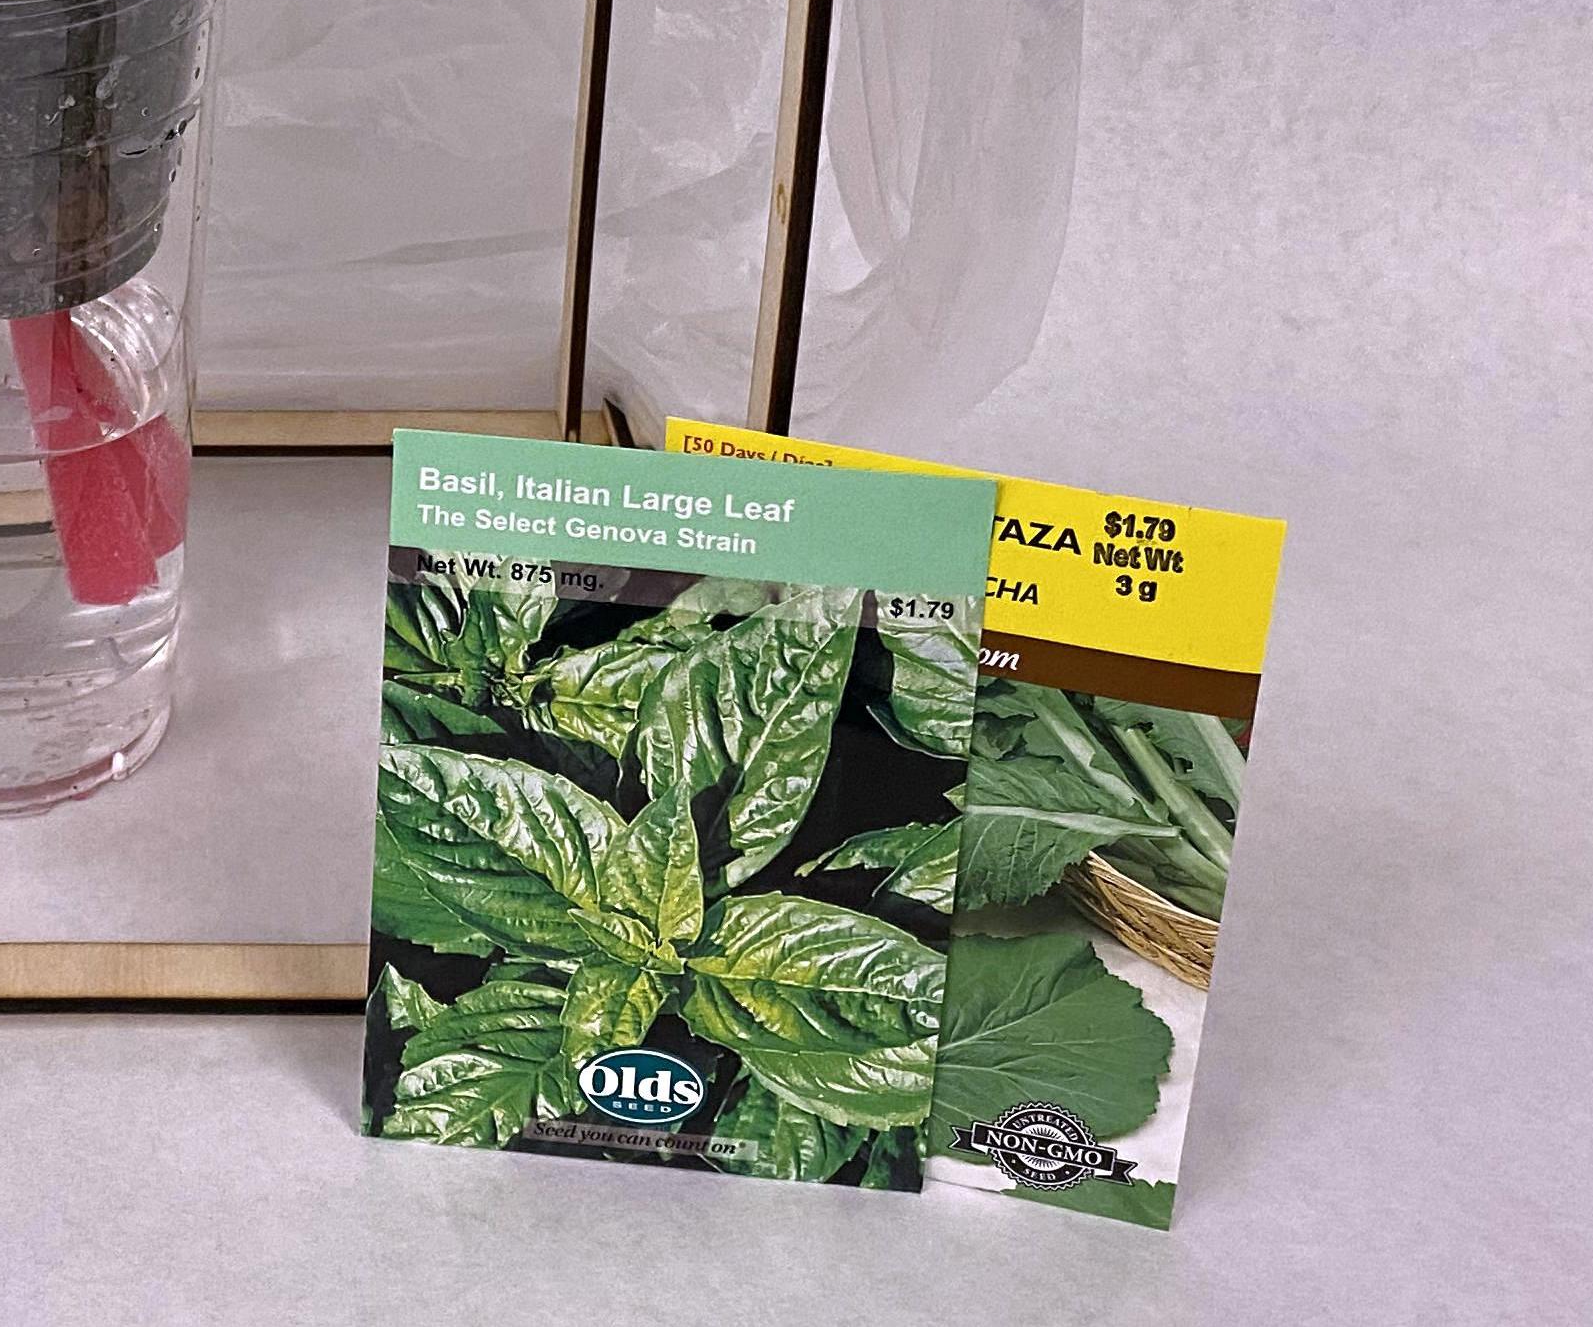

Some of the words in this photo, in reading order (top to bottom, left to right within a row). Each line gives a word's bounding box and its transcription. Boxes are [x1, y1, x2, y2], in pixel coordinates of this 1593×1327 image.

[683, 435, 714, 454] [50
[418, 466, 505, 501] Basil,
[515, 474, 610, 507] Italian
[622, 484, 713, 520] Large
[724, 494, 796, 524] Leaf
[417, 504, 466, 528] The
[474, 508, 557, 536] Select
[565, 517, 668, 546] Genova
[676, 527, 756, 555] Strain
[1104, 510, 1176, 542] $1.79
[1092, 541, 1141, 569] Net
[1144, 547, 1184, 573] Wt
[416, 554, 456, 576] Net
[463, 559, 502, 580] Wt.
[510, 562, 552, 584] 875
[560, 571, 605, 595] mg.
[1115, 574, 1133, 596] 3
[1138, 580, 1158, 602] g
[889, 597, 954, 620] $1.79
[579, 1064, 701, 1105] Olds
[612, 1101, 672, 1113] SEED
[533, 1122, 577, 1139] Seed
[579, 1129, 612, 1144] you
[617, 1133, 652, 1147] can
[655, 1135, 708, 1152] count
[1012, 1114, 1079, 1141] UNTREATED
[986, 1129, 1103, 1166] NON-GMO
[1024, 1168, 1057, 1181] SEED
